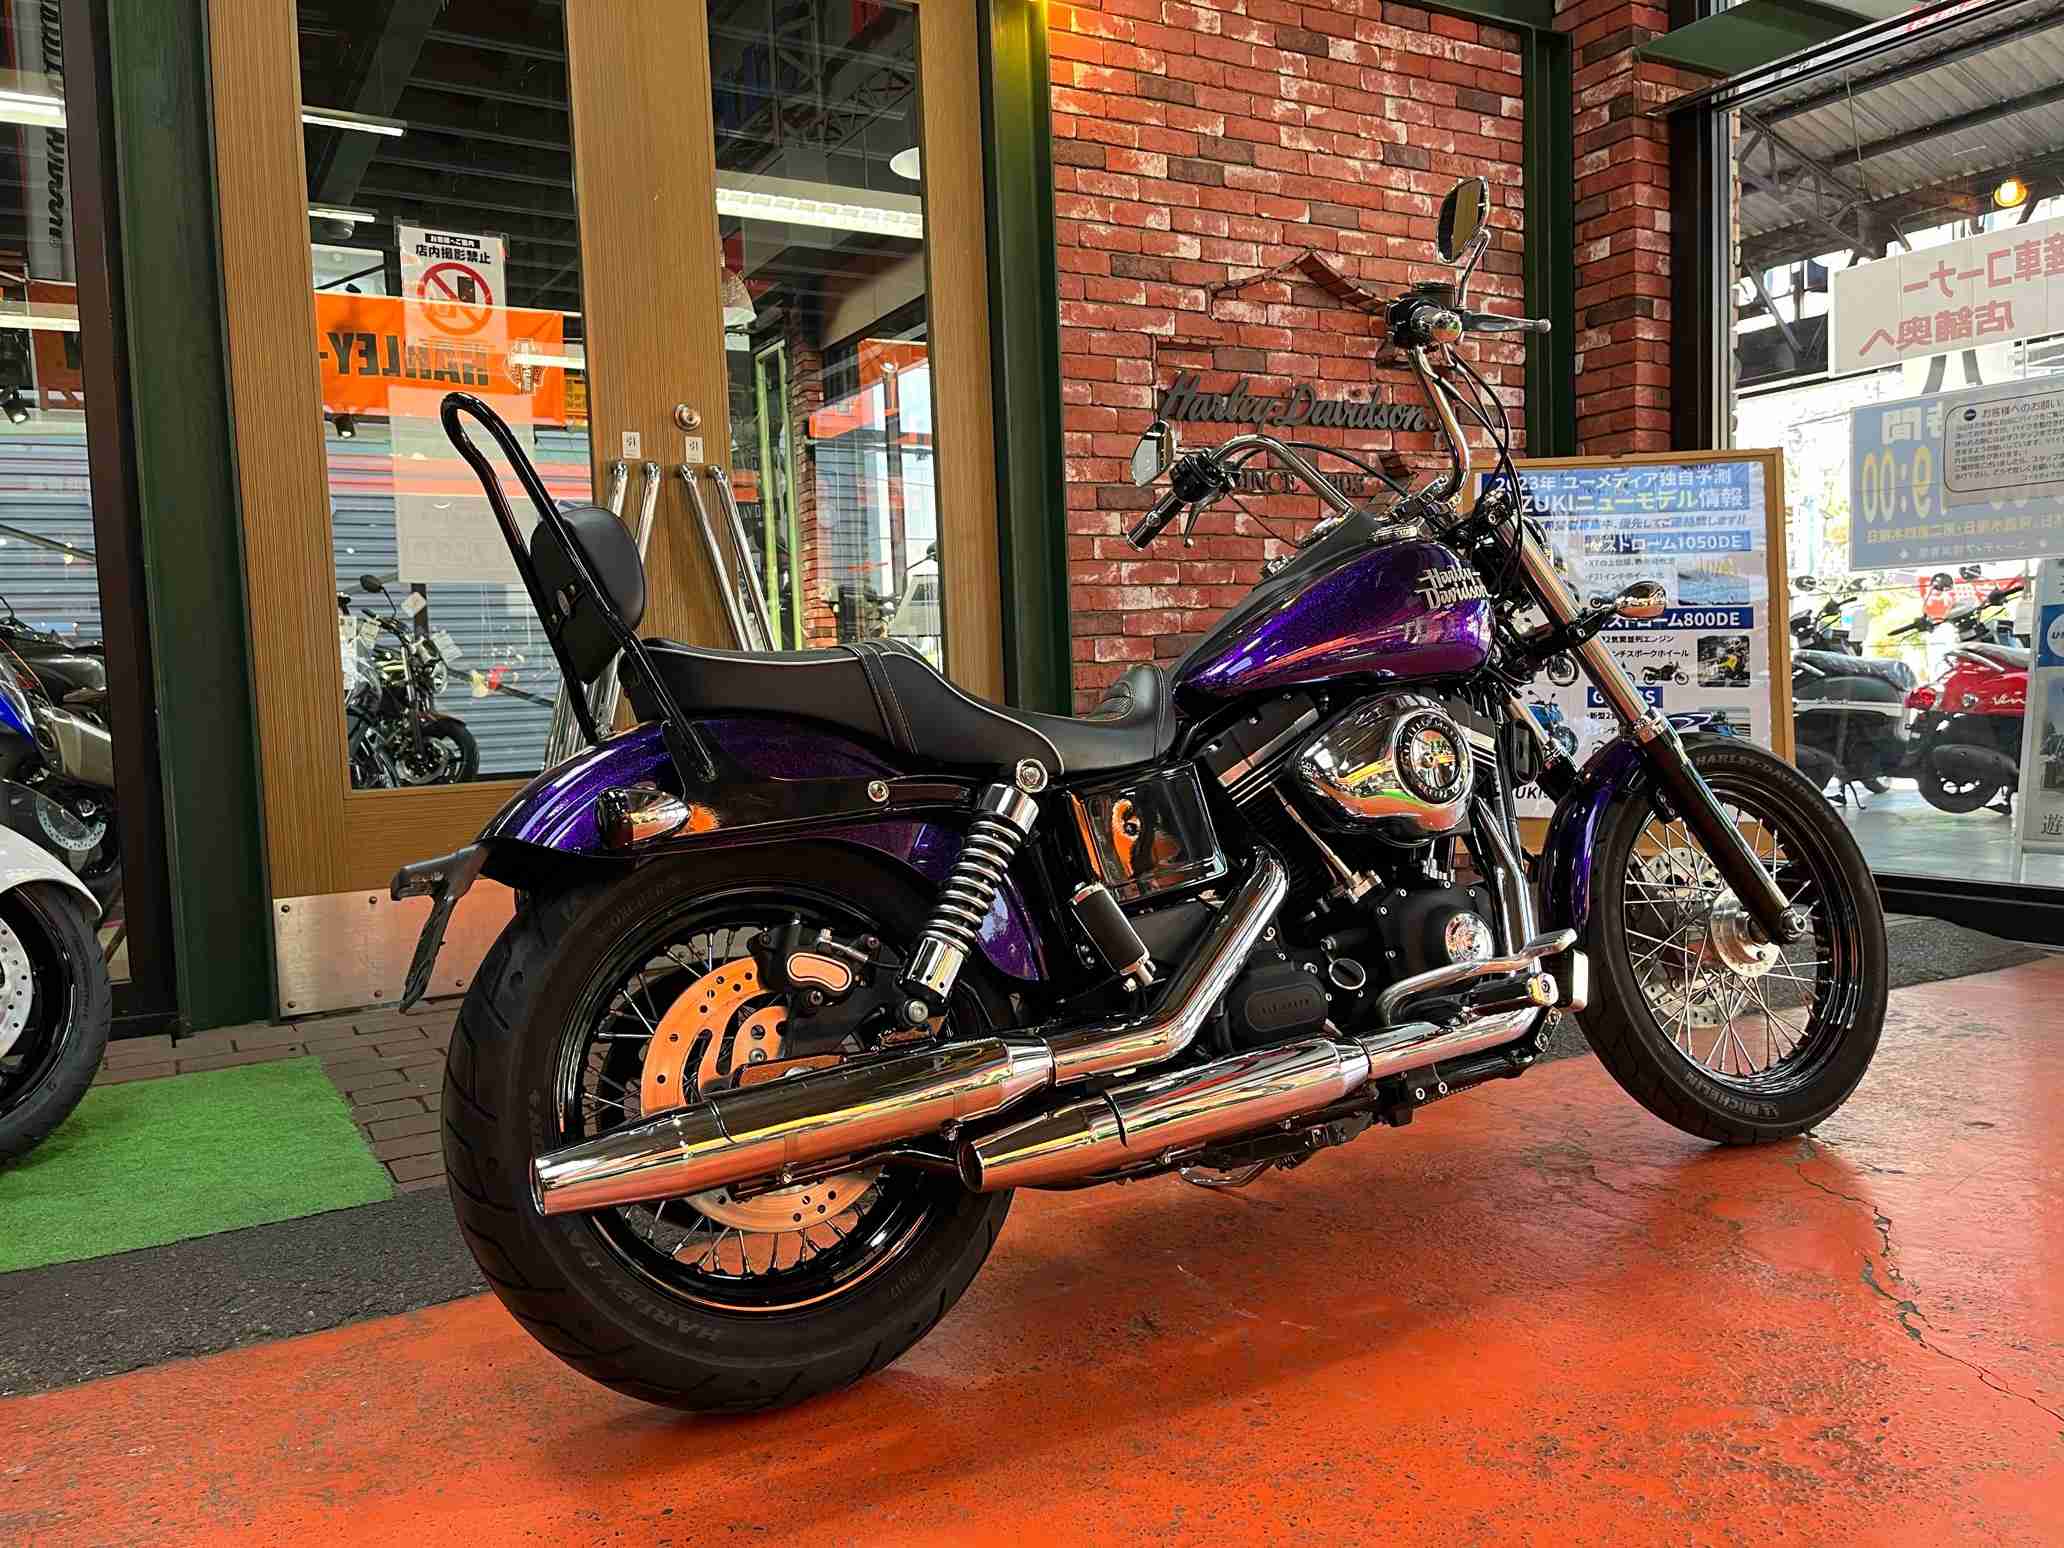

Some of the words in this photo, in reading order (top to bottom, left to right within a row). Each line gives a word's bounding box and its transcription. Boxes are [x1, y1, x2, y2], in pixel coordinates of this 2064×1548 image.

[416, 244, 491, 265] 店内撮影禁止
[1562, 468, 1732, 490] ユーメディア独自予測
[1521, 488, 1744, 513] ZUKIニューモデル情報
[1601, 611, 1741, 628] ストローム800DE
